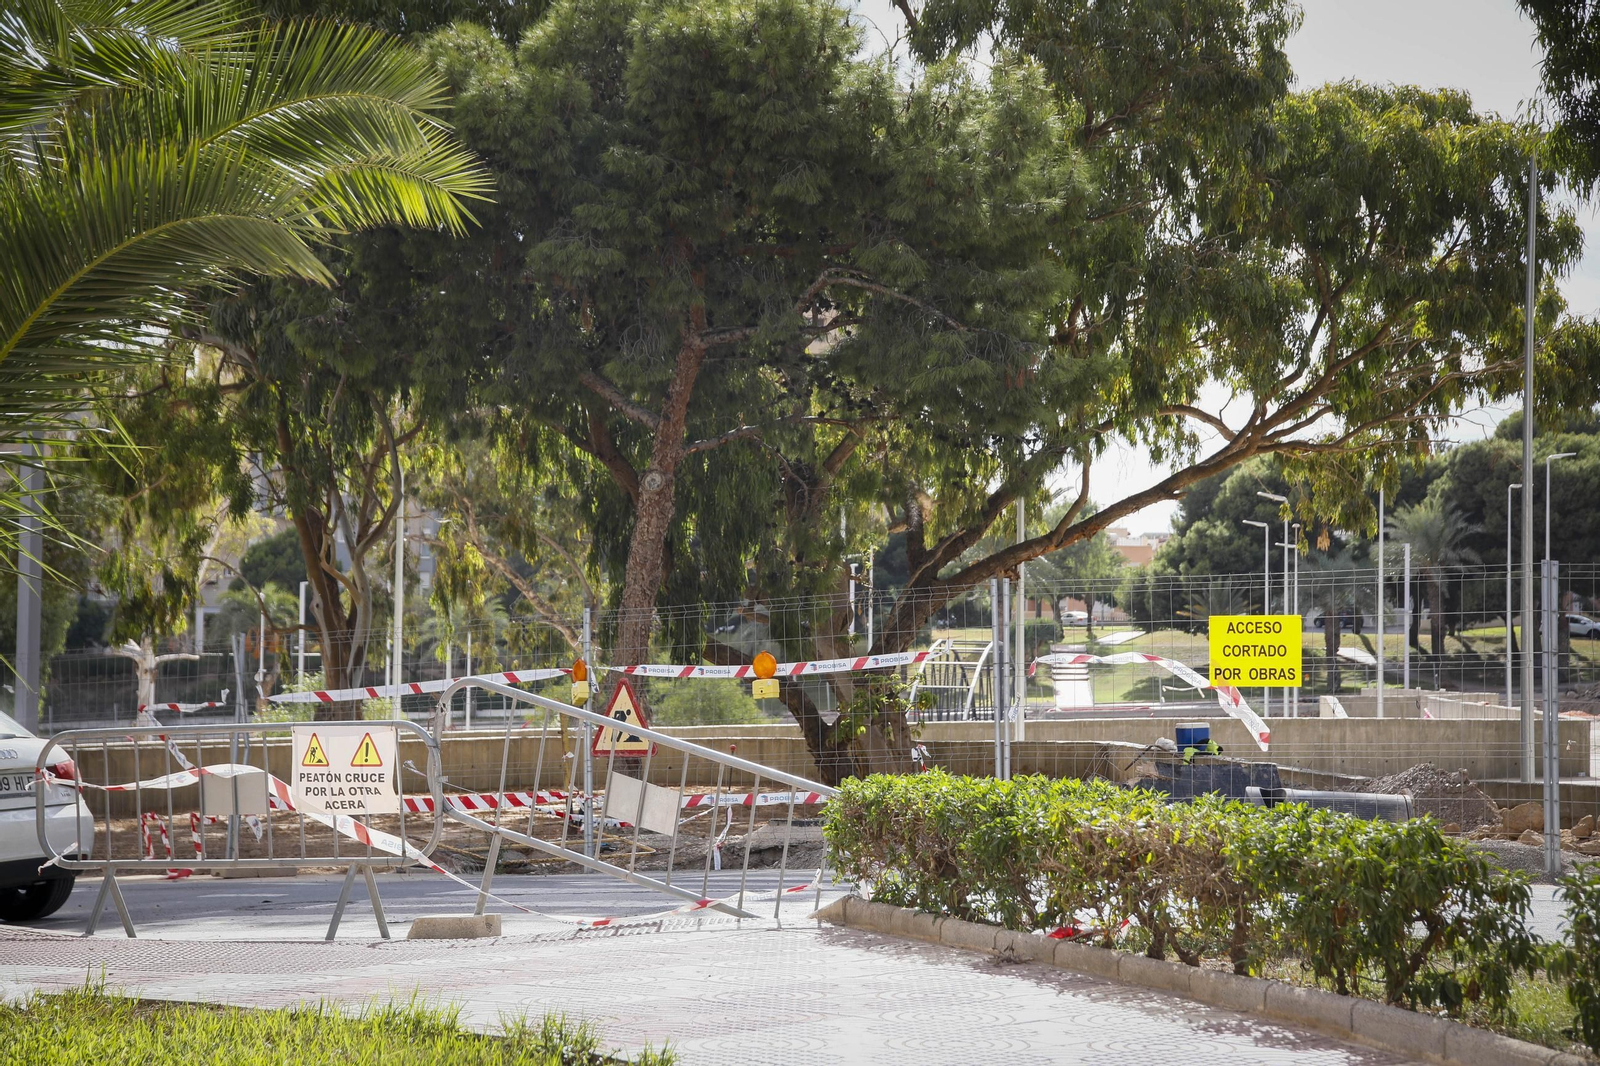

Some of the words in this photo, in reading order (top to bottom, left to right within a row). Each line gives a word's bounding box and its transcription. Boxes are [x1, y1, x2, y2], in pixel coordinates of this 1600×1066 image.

[1226, 621, 1282, 634] ACCESO
[1222, 644, 1287, 657] CORTADO
[880, 655, 909, 664] PROBISA
[1214, 668, 1241, 680] POR
[1248, 668, 1296, 680] OBRAS
[299, 770, 341, 783] PEATÓN
[345, 773, 385, 783] CRUCE
[305, 786, 327, 797] POR
[330, 786, 345, 797] LA
[348, 786, 382, 797] OTRA
[324, 800, 366, 810] ACERA
